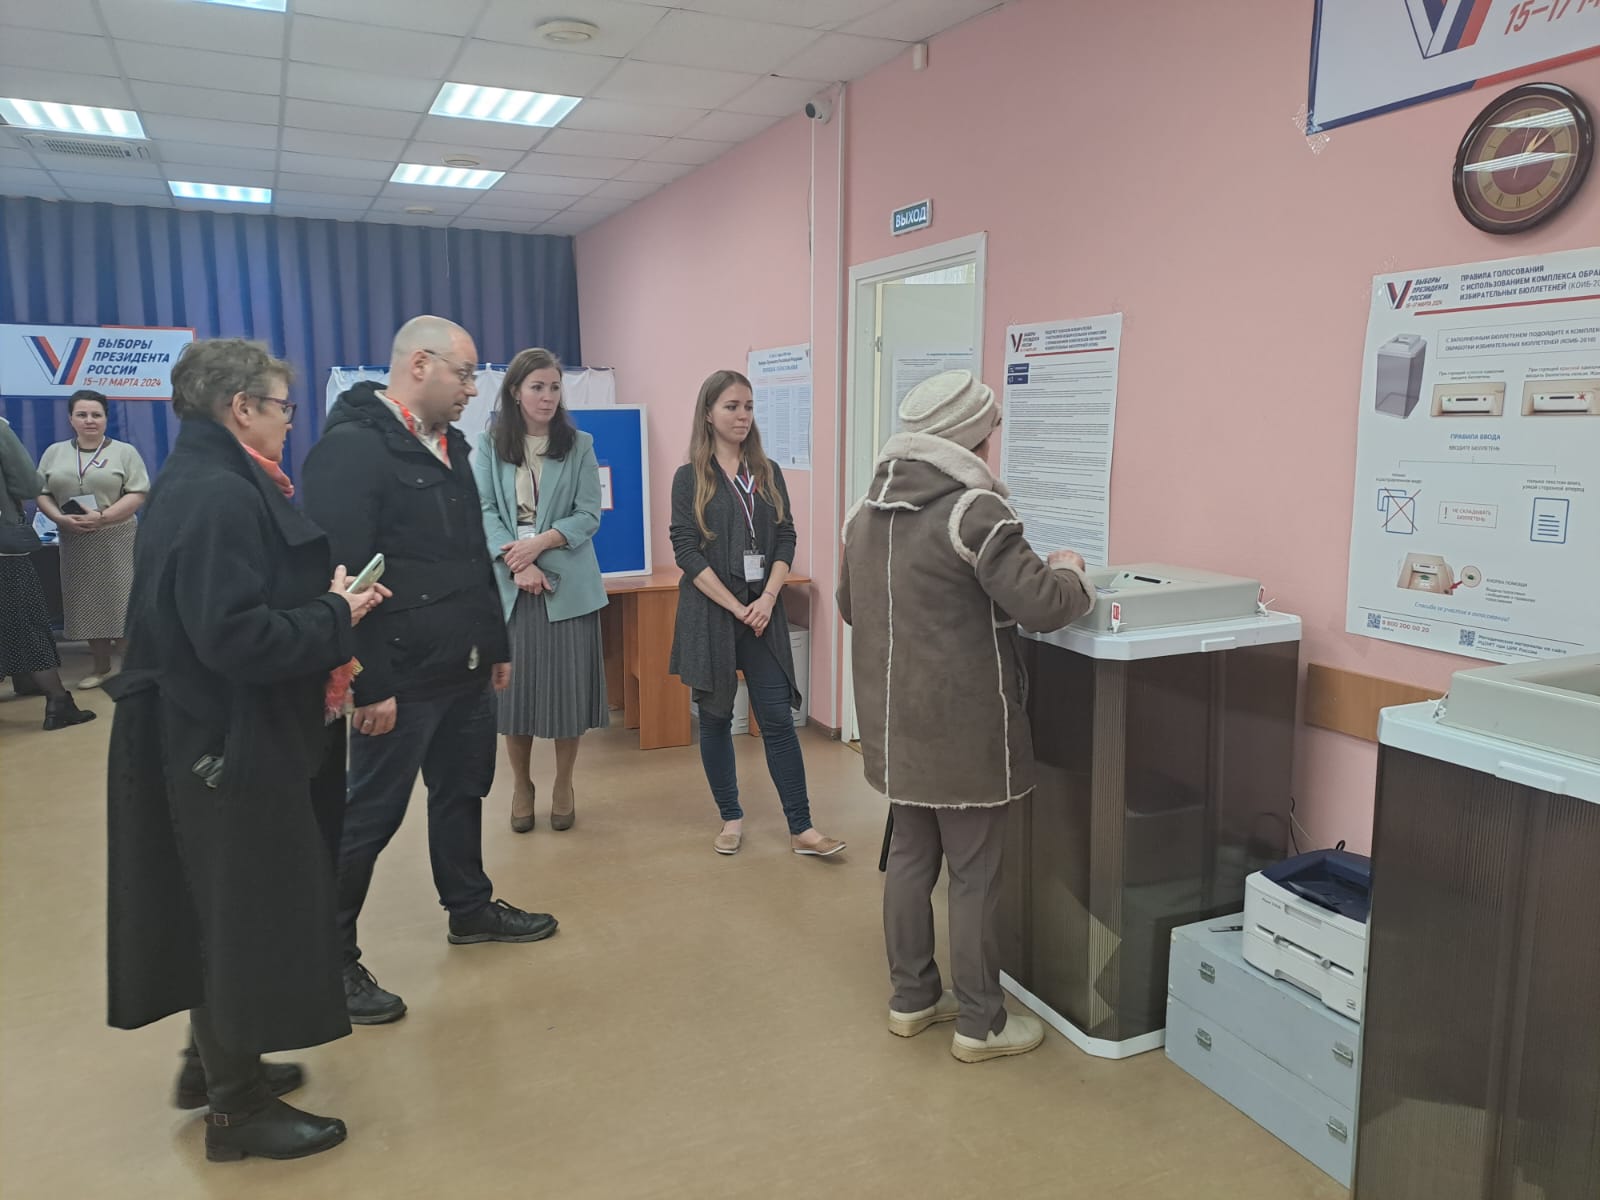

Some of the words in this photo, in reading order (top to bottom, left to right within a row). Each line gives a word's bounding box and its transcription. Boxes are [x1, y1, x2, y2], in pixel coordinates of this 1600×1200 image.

[895, 207, 927, 228] ВЫХОД
[1460, 271, 1491, 281] ПРАВИЛА
[1493, 265, 1544, 277] ГОЛОСОВАНИЯ
[1415, 276, 1442, 286] ВЫБОРЫ
[1466, 277, 1530, 290] ИСПОЛЬЗОВАНИЕМ
[1531, 272, 1577, 283] КОМПЛЕКСА
[1411, 284, 1449, 293] ПРЕЗИДЕНТА
[1459, 289, 1517, 300] ИЗБИРАТЕЛЬНЫХ
[1518, 282, 1567, 294] БЮЛЛЕТЕНЕЙ
[1408, 293, 1433, 302] РОССИИ
[1529, 329, 1564, 338] ПОДОЙДИТЕ
[97, 338, 153, 349] ВЫБОРЫ
[92, 352, 170, 364] ПРЕЗИДЕНТА
[86, 364, 137, 376] РОССИИ
[109, 378, 139, 387] МАРТА
[140, 378, 162, 387] 2024
[1450, 433, 1479, 441] ПРАВИЛА
[1479, 433, 1501, 442] ВВОДА
[1387, 620, 1398, 628] 800
[1399, 622, 1411, 630] 200
